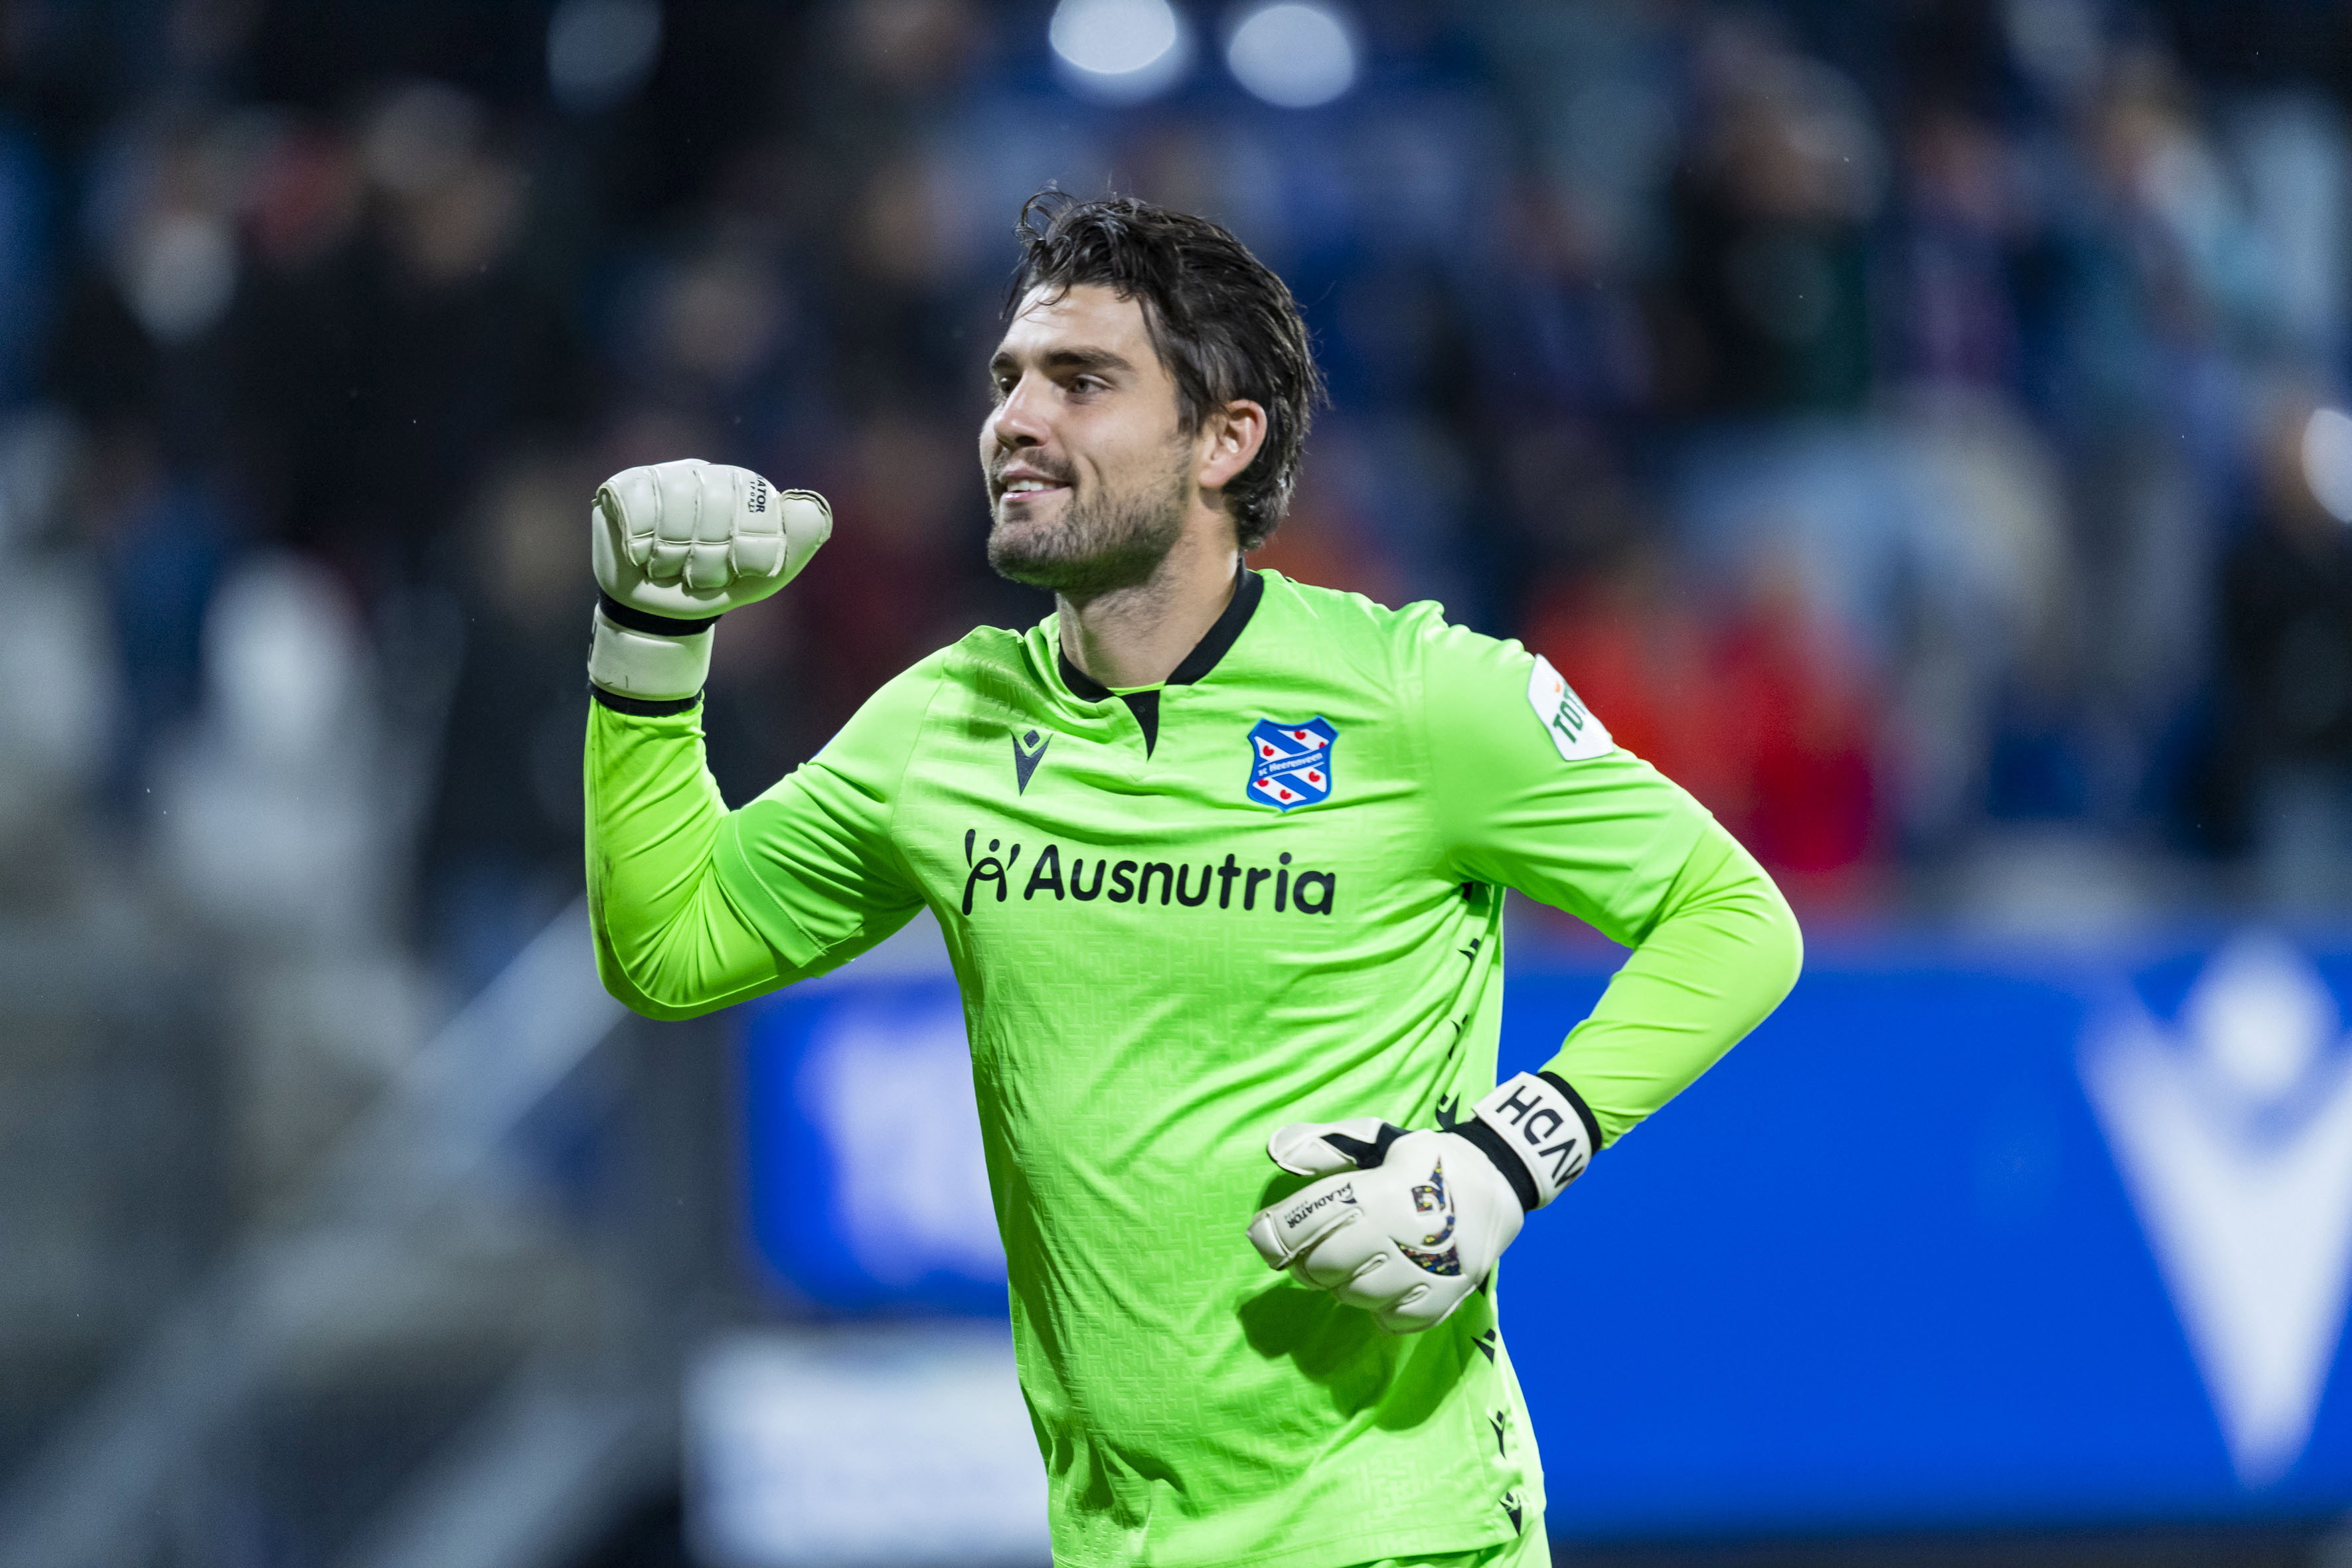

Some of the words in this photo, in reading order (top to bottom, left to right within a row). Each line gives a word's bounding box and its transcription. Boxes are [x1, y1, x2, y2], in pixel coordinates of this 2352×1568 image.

[1553, 681, 1587, 744] TOT
[1024, 844, 1336, 915] Ausnutria
[1287, 1182, 1354, 1229] GLADIATOR
